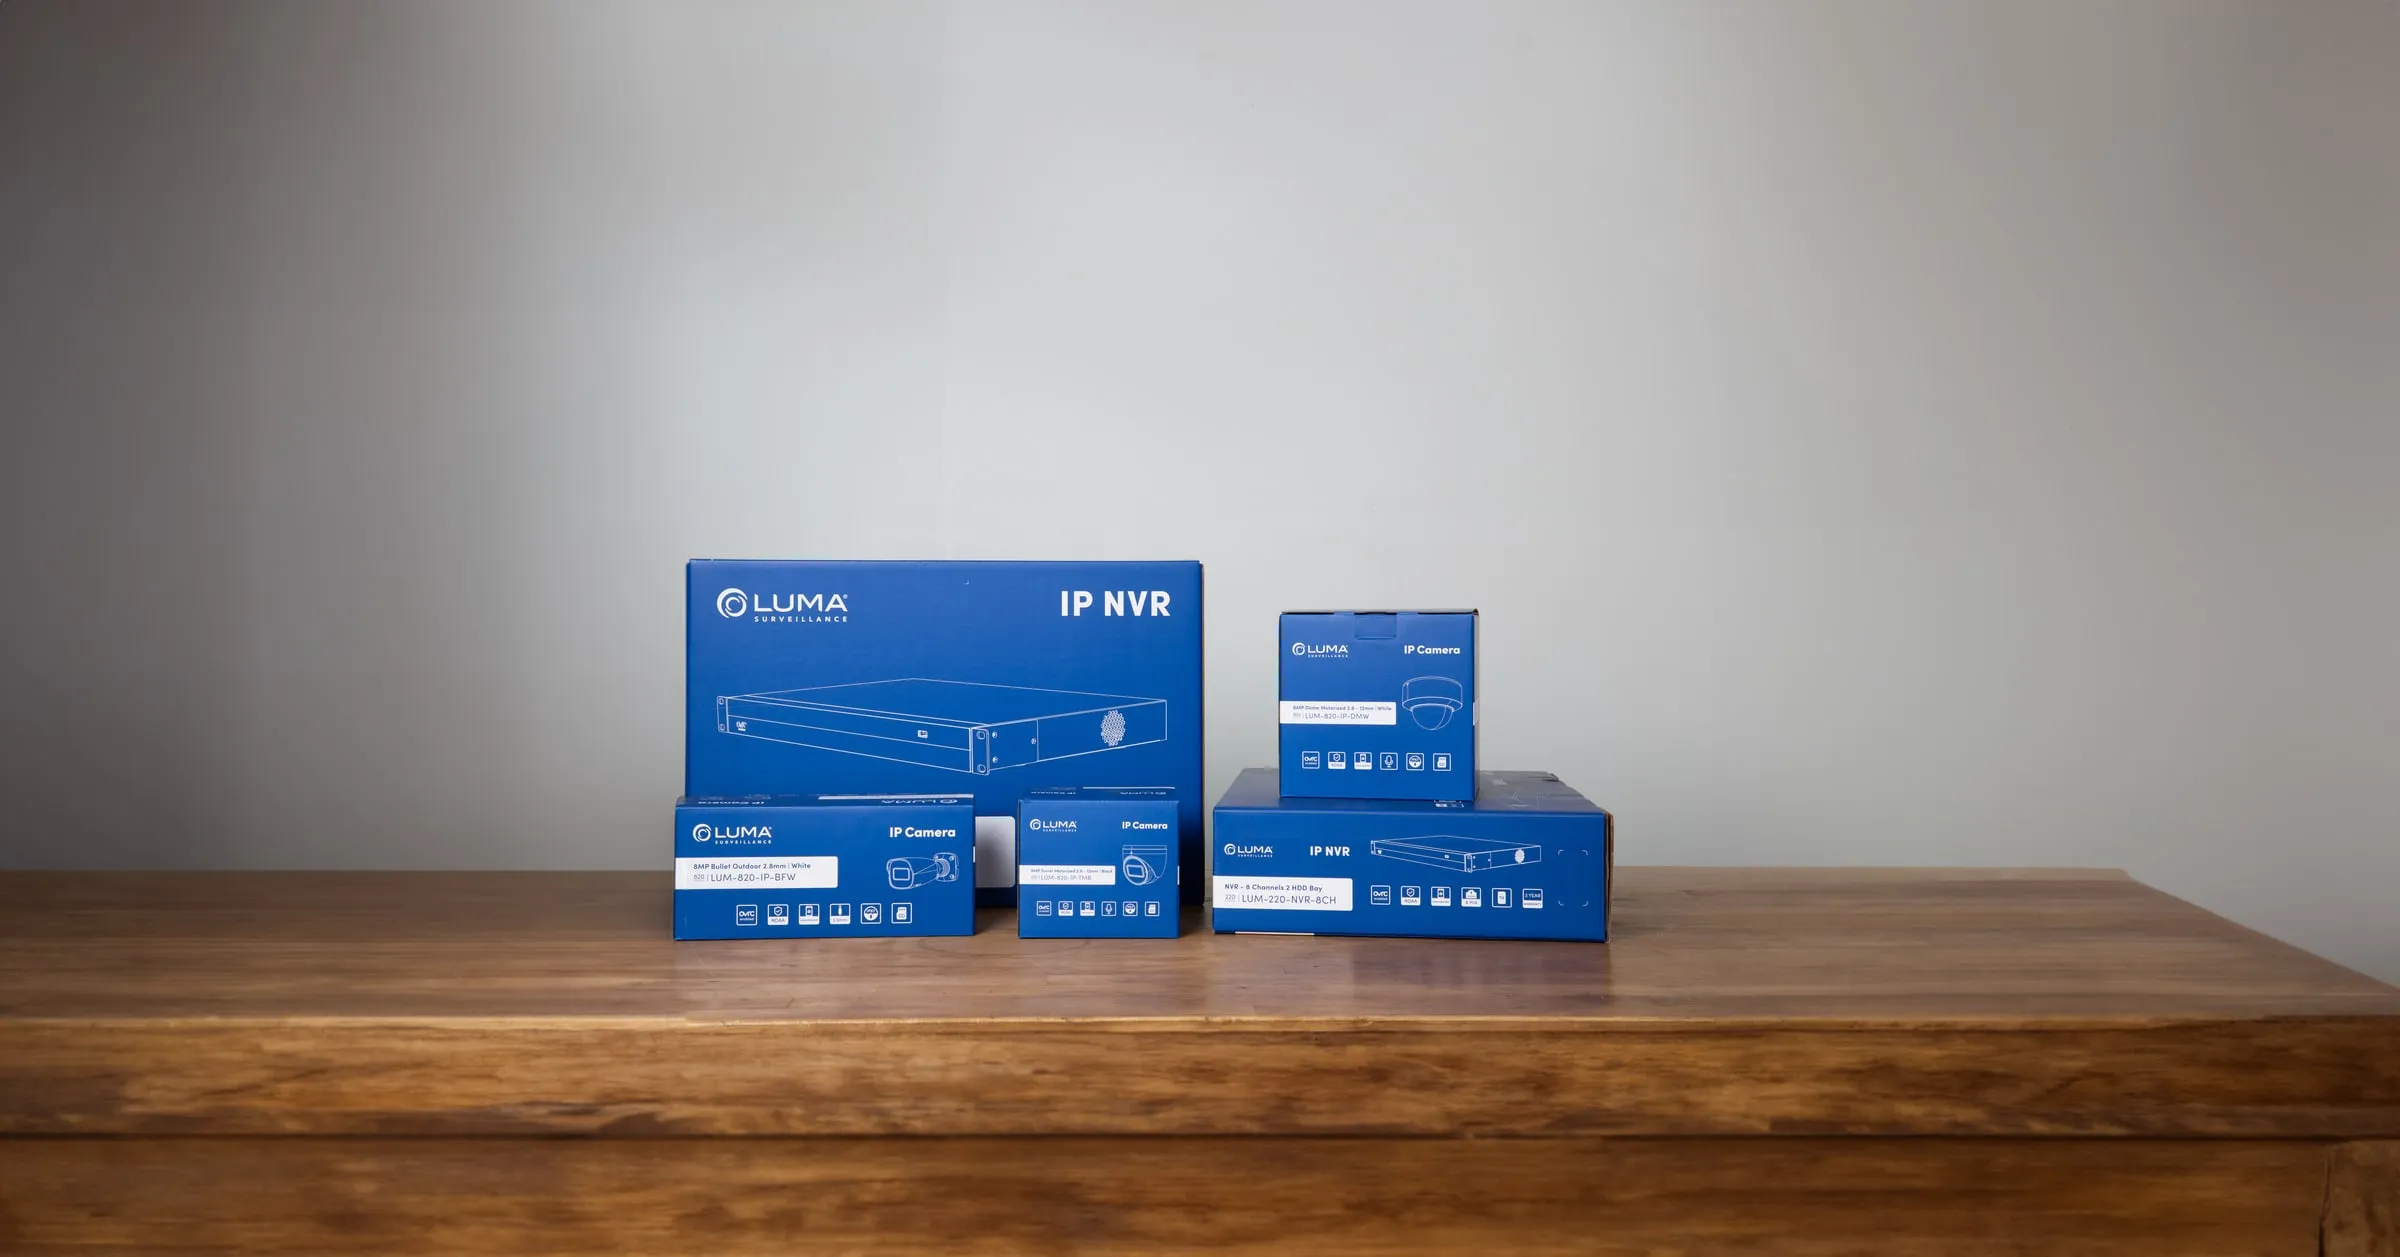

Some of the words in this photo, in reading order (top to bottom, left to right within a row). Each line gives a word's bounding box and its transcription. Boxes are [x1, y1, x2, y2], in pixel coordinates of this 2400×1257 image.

[1061, 590, 1093, 616] IP
[1104, 590, 1171, 616] NVR
[1308, 645, 1348, 653] LUMA
[1404, 645, 1415, 655] IP
[1417, 645, 1461, 655] Camera
[715, 827, 772, 838] LUMA
[890, 827, 902, 838] IP
[905, 827, 956, 838] Camera
[1238, 846, 1273, 854] LUMA
[1310, 846, 1322, 856] IP
[1326, 846, 1350, 856] NVR
[710, 873, 796, 882] LUM-820-IP-BFW
[1242, 895, 1336, 904] LUM-220-NVR-8CH
